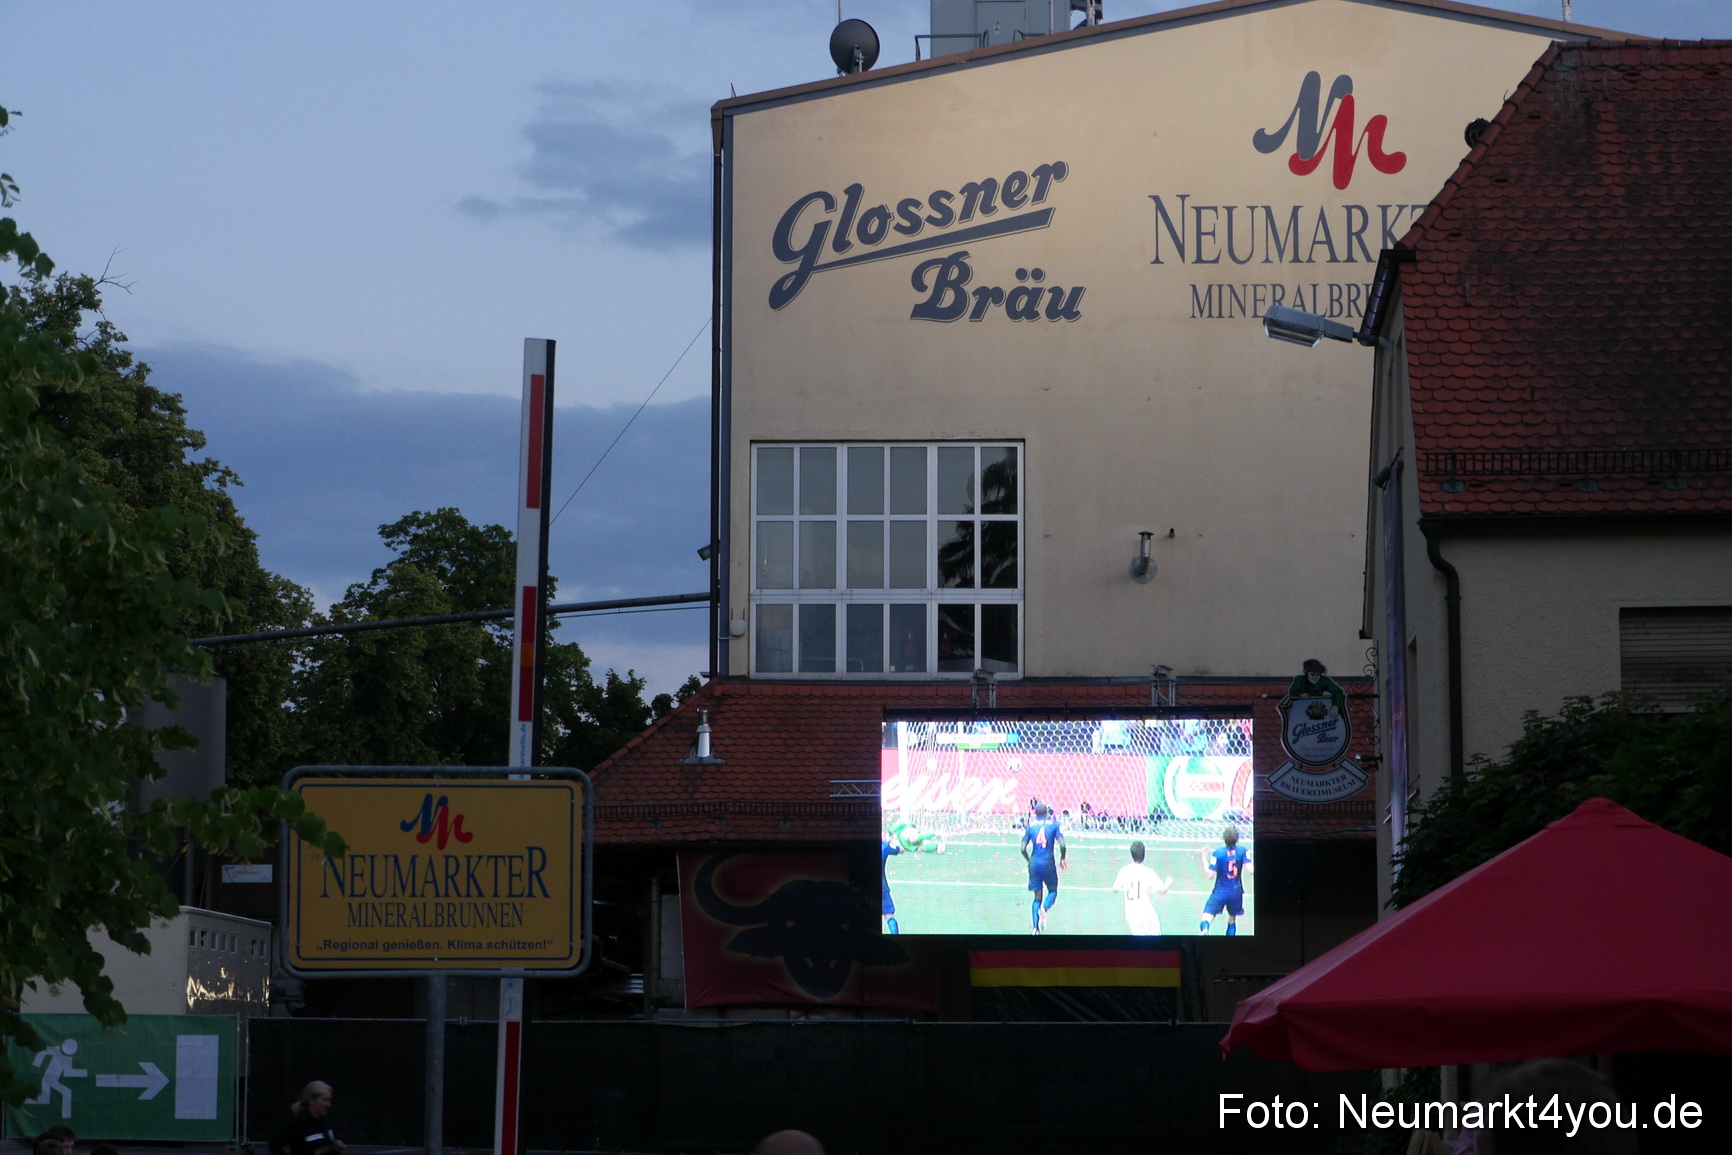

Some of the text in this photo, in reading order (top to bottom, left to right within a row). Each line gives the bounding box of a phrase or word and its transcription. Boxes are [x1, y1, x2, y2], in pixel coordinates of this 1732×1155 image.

[767, 160, 1069, 311] Glossner
[909, 250, 1086, 323] Bräu
[1292, 718, 1339, 745] Glossner
[1316, 732, 1339, 744] Bier
[1279, 779, 1357, 796] BRAUEREIMUSEUM
[1290, 773, 1348, 788] NEUMARKTER
[1035, 826, 1047, 849] 4
[320, 846, 550, 898] NEUMARKTER
[1226, 858, 1238, 880] 5
[1126, 880, 1141, 901] 21
[346, 902, 524, 928] MINERALBRUNNEN
[447, 939, 483, 950] Klima
